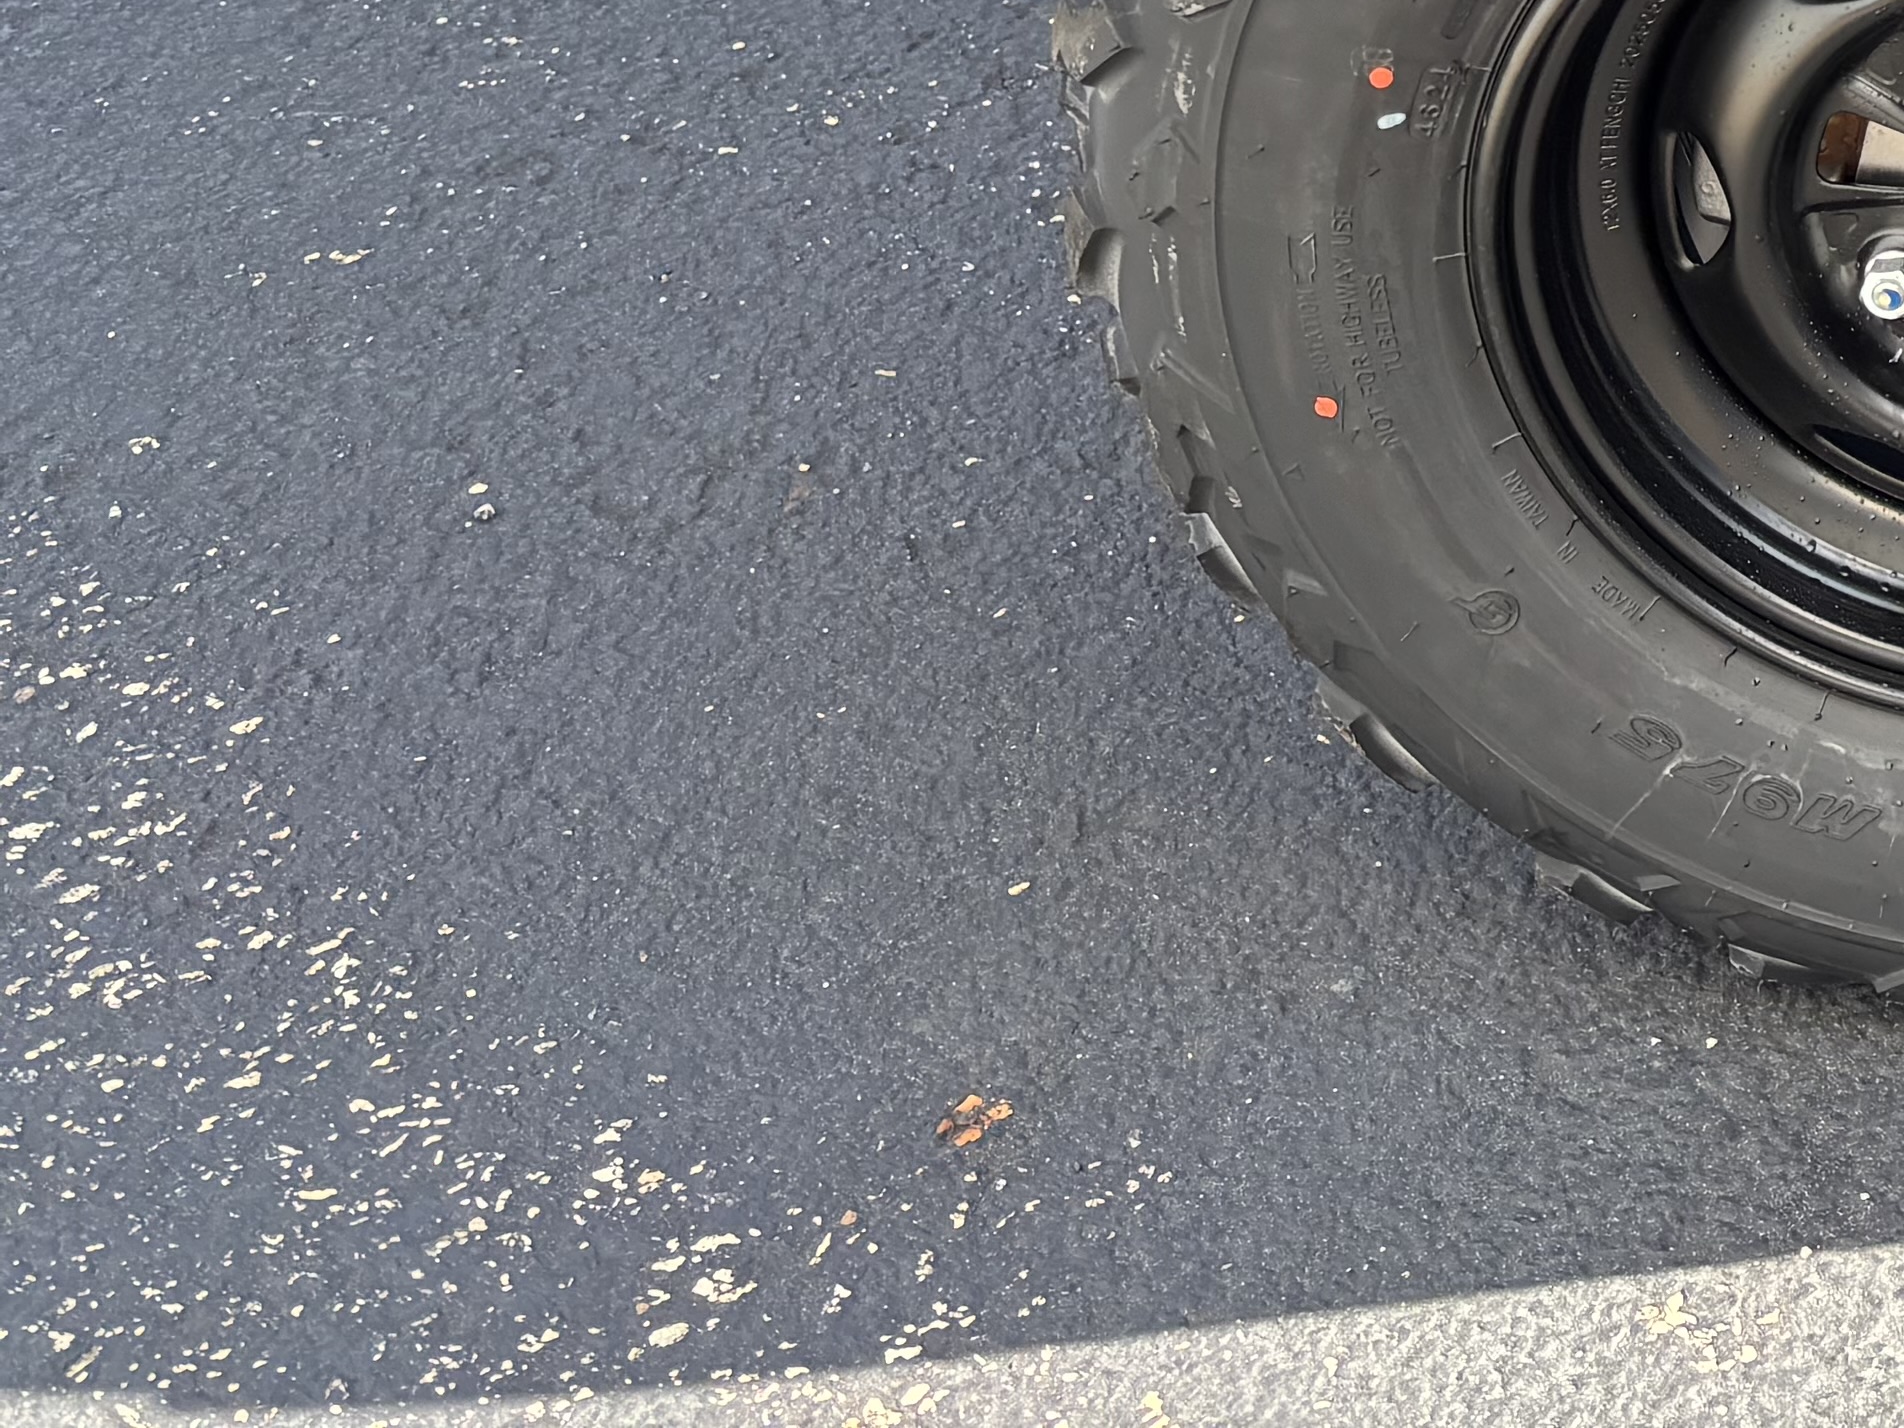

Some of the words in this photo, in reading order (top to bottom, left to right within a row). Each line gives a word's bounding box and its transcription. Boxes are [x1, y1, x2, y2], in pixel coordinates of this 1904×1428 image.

[1329, 203, 1355, 246] USE
[1330, 258, 1367, 347] HIGHWAY
[1348, 351, 1381, 399] FOR
[1366, 401, 1401, 449] NOT
[1501, 467, 1549, 533] TAIWAN
[1557, 540, 1581, 568] IN
[1590, 574, 1644, 624] MADE
[1609, 713, 1883, 842] M975
